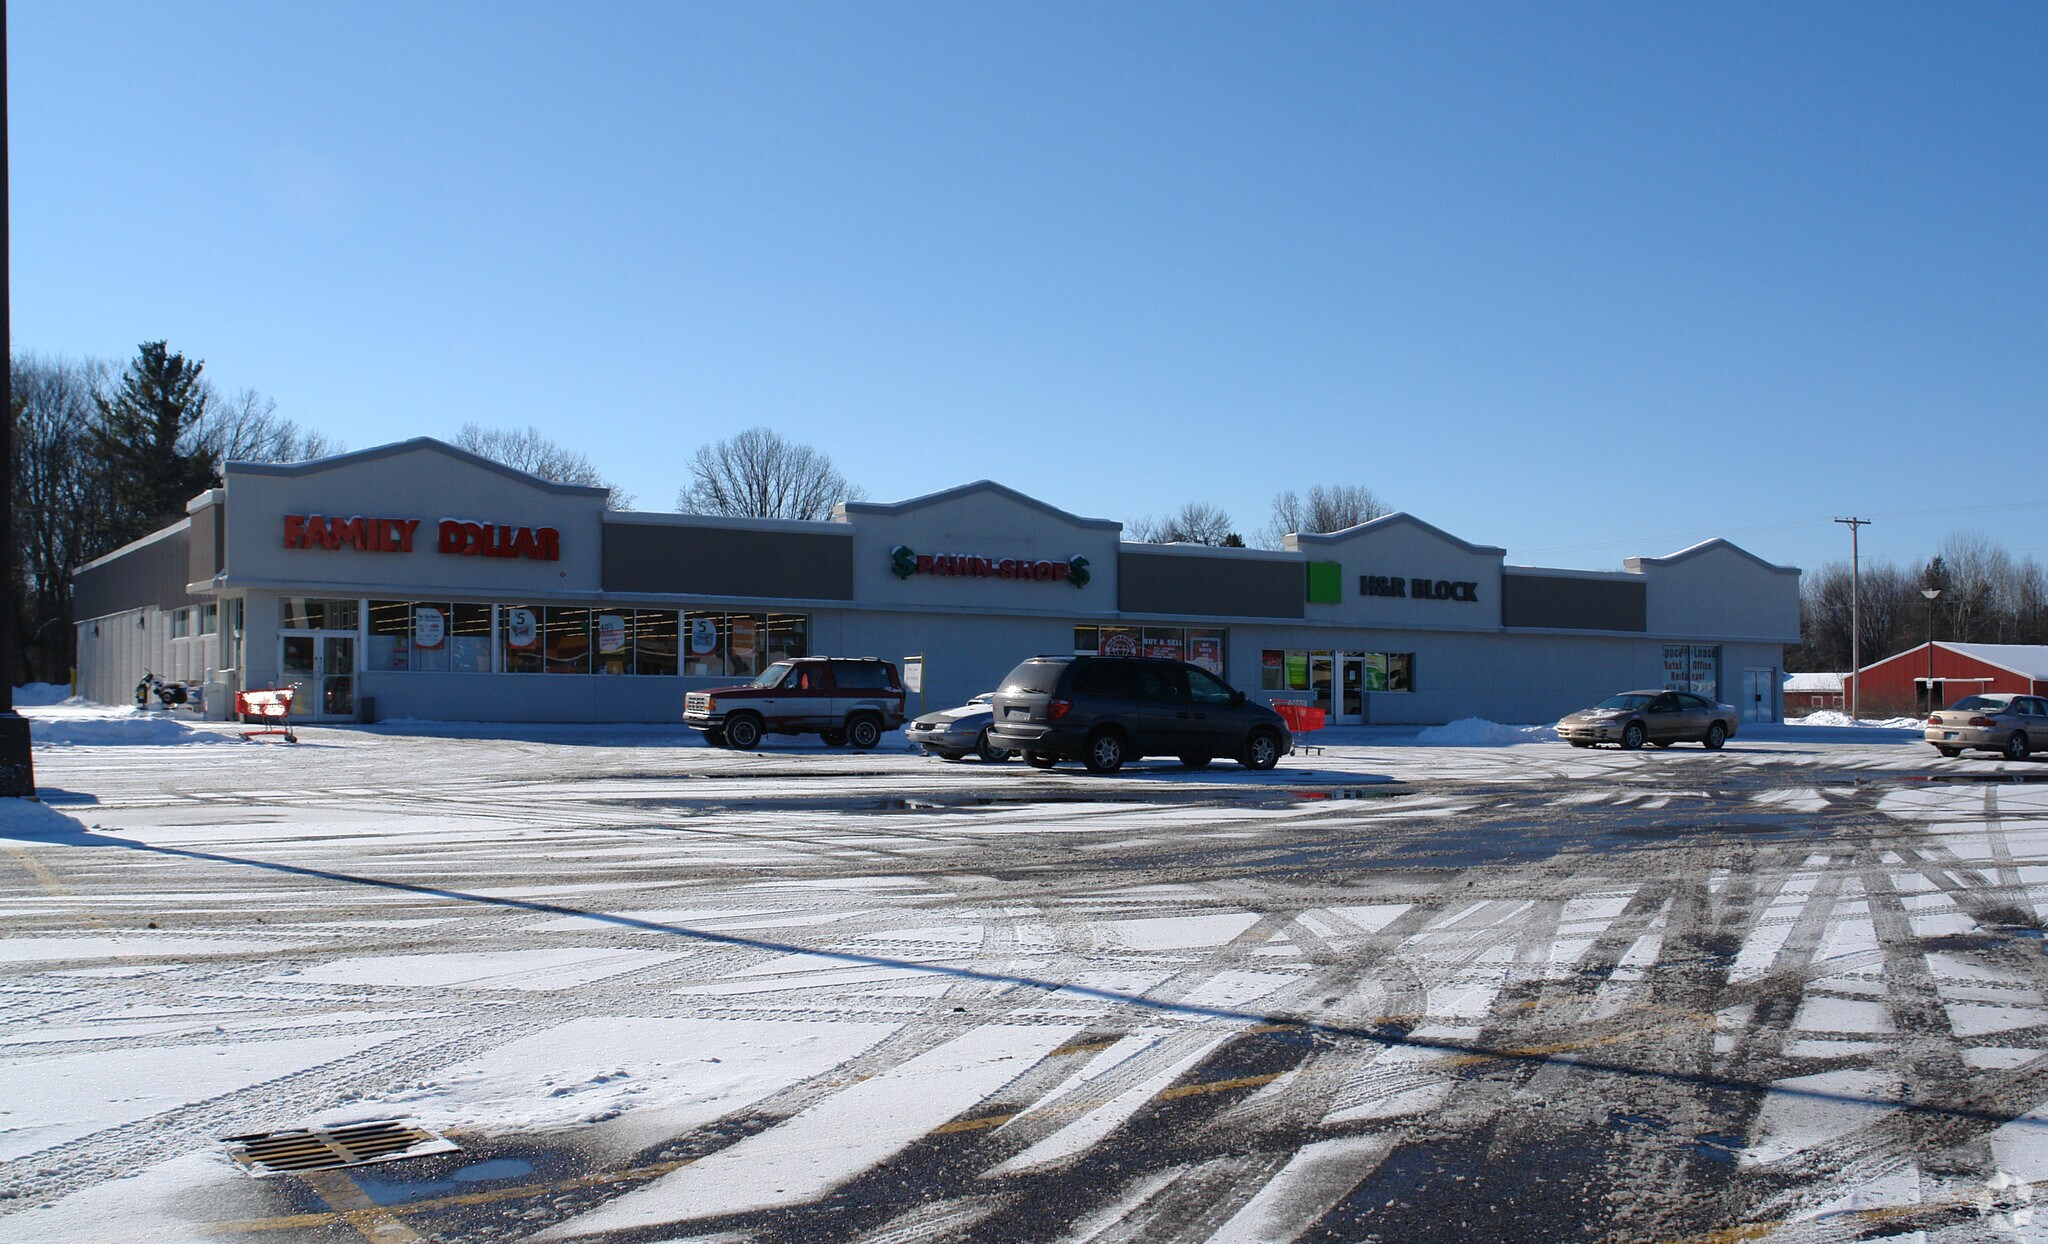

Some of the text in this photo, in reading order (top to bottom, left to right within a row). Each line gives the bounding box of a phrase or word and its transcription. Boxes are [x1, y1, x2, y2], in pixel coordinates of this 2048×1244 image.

[283, 514, 560, 561] FAMILY DOLLAR
[1360, 575, 1479, 602] H&R BLOCK
